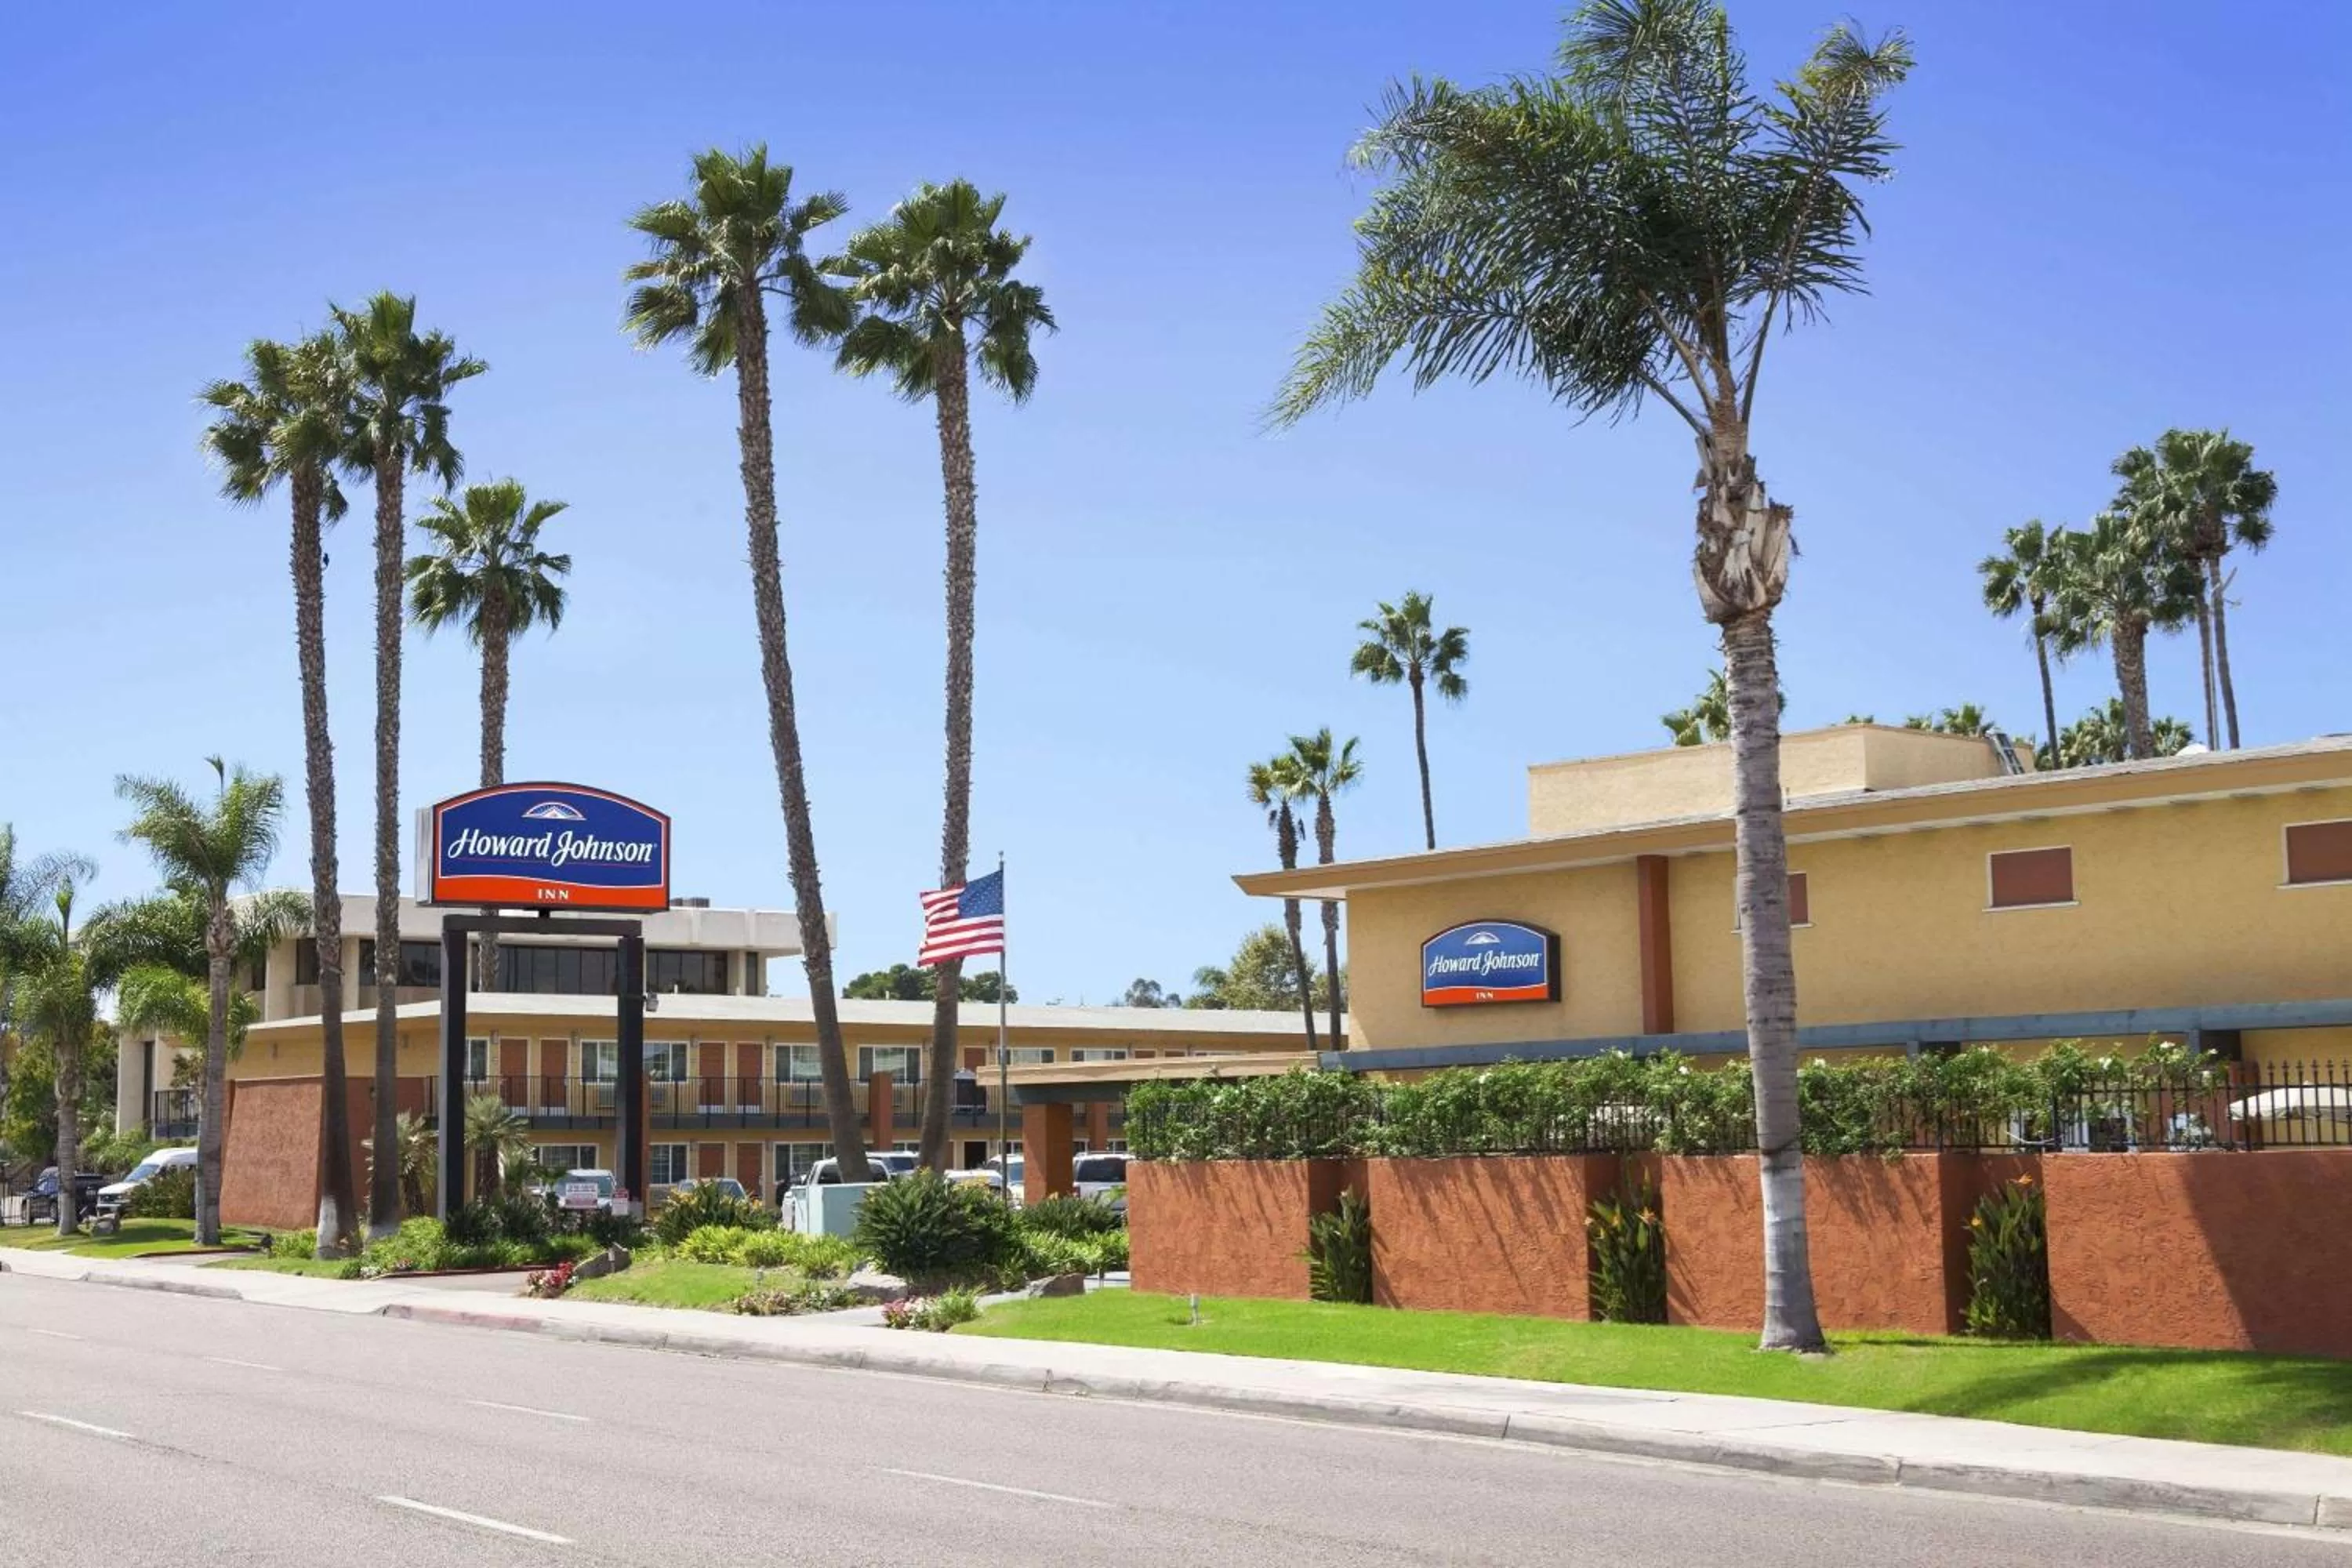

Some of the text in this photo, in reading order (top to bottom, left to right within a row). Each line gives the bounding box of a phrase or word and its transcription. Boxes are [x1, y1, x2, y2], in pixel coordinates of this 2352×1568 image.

[448, 828, 653, 866] Howard Johnson
[538, 888, 568, 899] INN
[1428, 950, 1540, 976] Howard Johnson
[1476, 991, 1494, 1000] INN
